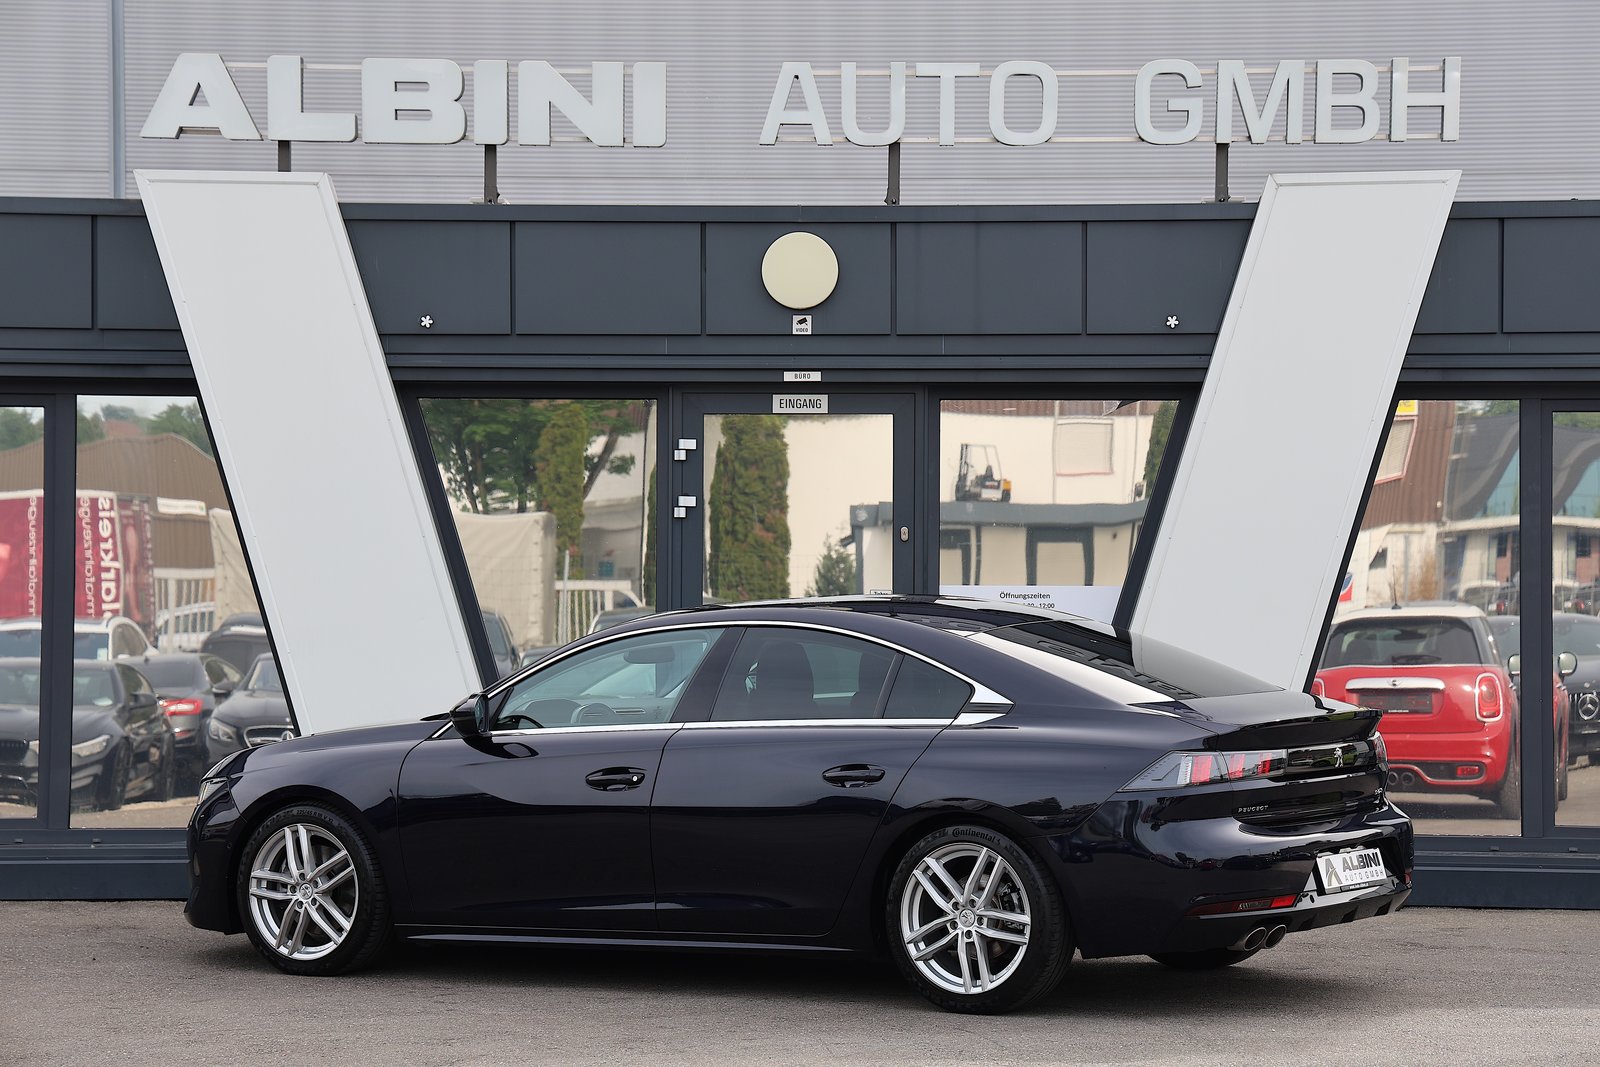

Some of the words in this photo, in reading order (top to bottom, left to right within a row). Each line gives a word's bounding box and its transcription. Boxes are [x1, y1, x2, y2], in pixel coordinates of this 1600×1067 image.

[139, 52, 667, 147] ALBINI
[759, 59, 1059, 146] AUTO
[1134, 56, 1462, 145] GMBH
[779, 398, 822, 409] EINGANG
[999, 591, 1051, 600] Öffnungszeiten
[1238, 805, 1269, 813] PEUGEOT
[952, 828, 996, 843] Continental
[1343, 852, 1381, 873] ALBINI
[1344, 872, 1363, 882] AUTO
[1364, 869, 1384, 879] GMBH
